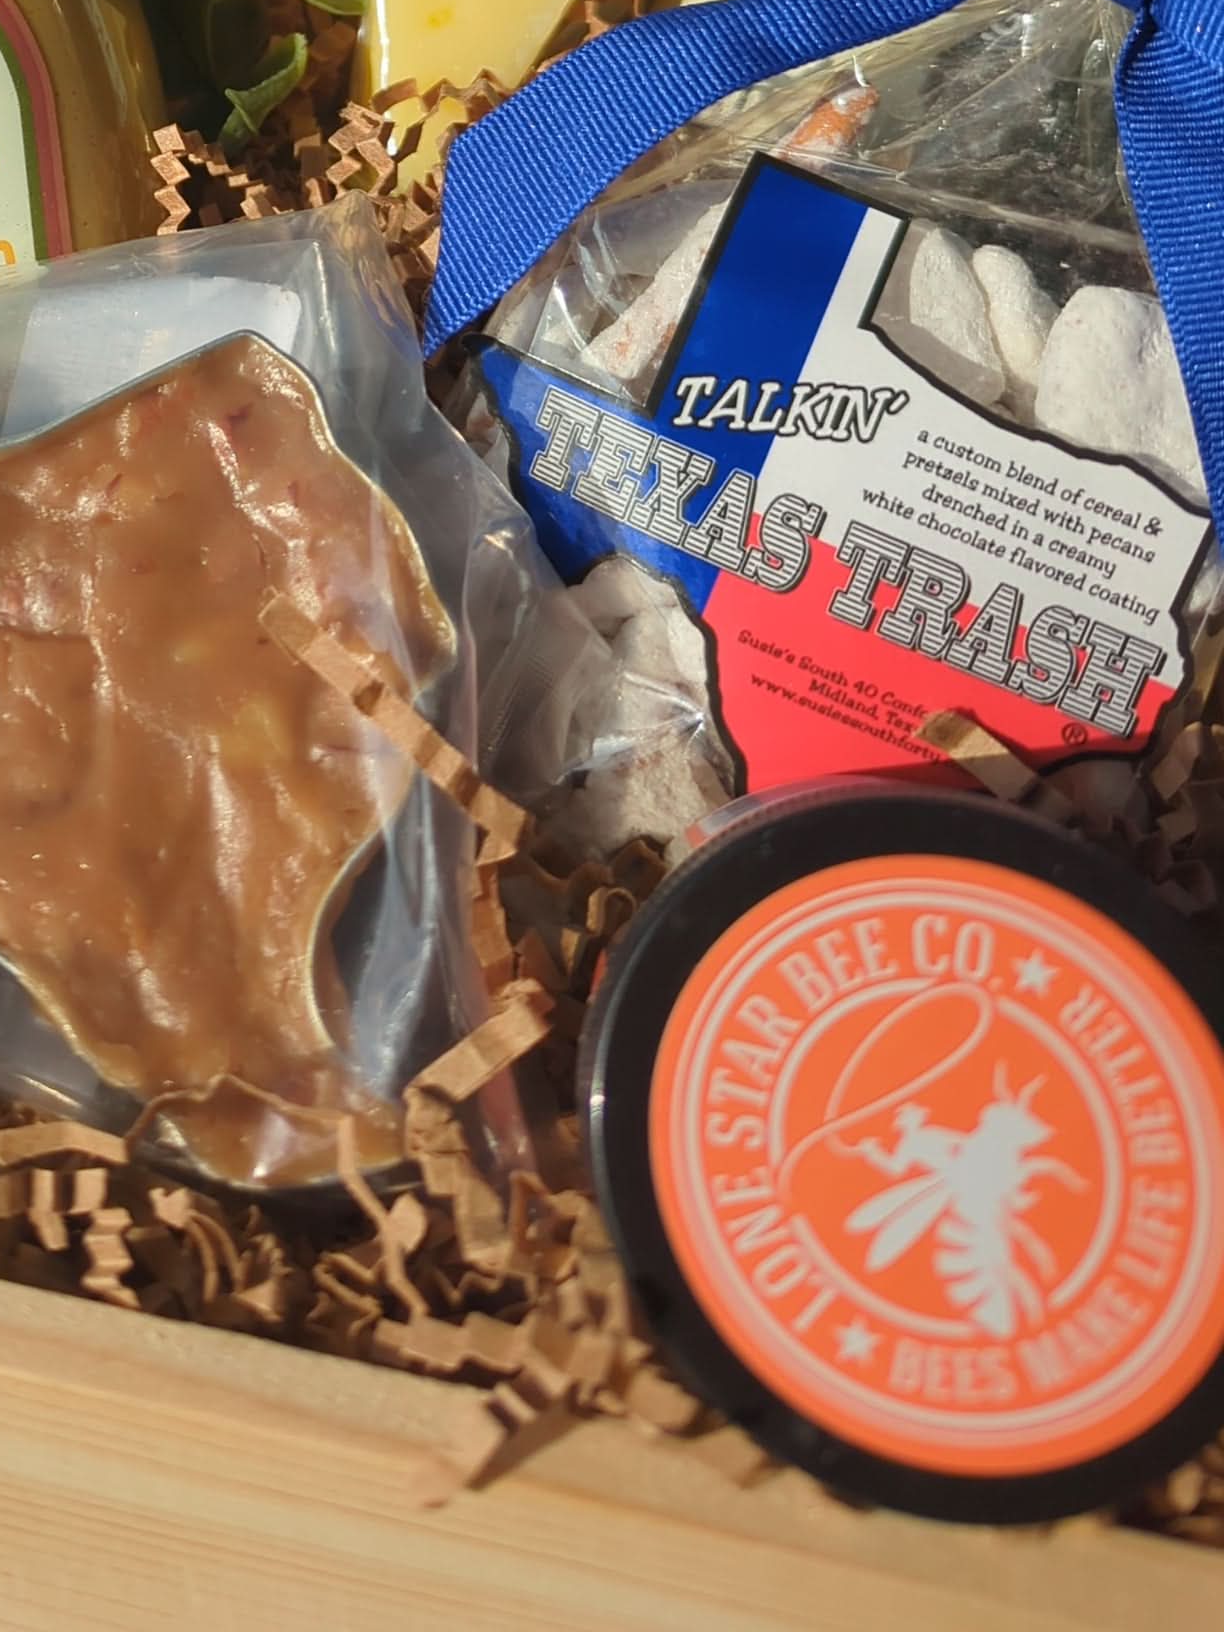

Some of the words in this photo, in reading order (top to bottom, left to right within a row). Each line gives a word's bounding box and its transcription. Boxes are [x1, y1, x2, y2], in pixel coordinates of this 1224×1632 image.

[673, 374, 910, 443] TALKIN'
[903, 451, 980, 492] pretzels
[983, 481, 1041, 516] mixed
[1043, 507, 1086, 537] with
[1091, 524, 1156, 563] pecans
[917, 429, 929, 444] a
[933, 434, 1002, 475] custom
[1006, 461, 1057, 496] blend
[1060, 488, 1084, 506] of
[1083, 496, 1142, 530] cereal
[1144, 518, 1164, 538] &
[922, 484, 1009, 531] drenched
[1010, 519, 1029, 540] in
[1032, 532, 1044, 546] a
[1049, 538, 1117, 580] creamy
[529, 384, 828, 594] TEXAS
[827, 520, 1168, 739] TRASH
[862, 488, 914, 521] white
[917, 511, 1007, 557] chocolate
[1010, 547, 1085, 591] flavored
[1089, 583, 1161, 625] coating
[737, 629, 796, 665] Susie's
[798, 655, 849, 687] South
[853, 679, 879, 697] 40
[779, 916, 901, 1015] BEE
[910, 913, 1005, 991] CO.
[704, 992, 804, 1152] STAR
[1058, 984, 1185, 1167] BETTER
[719, 1172, 837, 1335] LONE
[1114, 1174, 1189, 1289] LIFE
[887, 1335, 1017, 1403] BEES
[1017, 1280, 1158, 1387] MAKE
